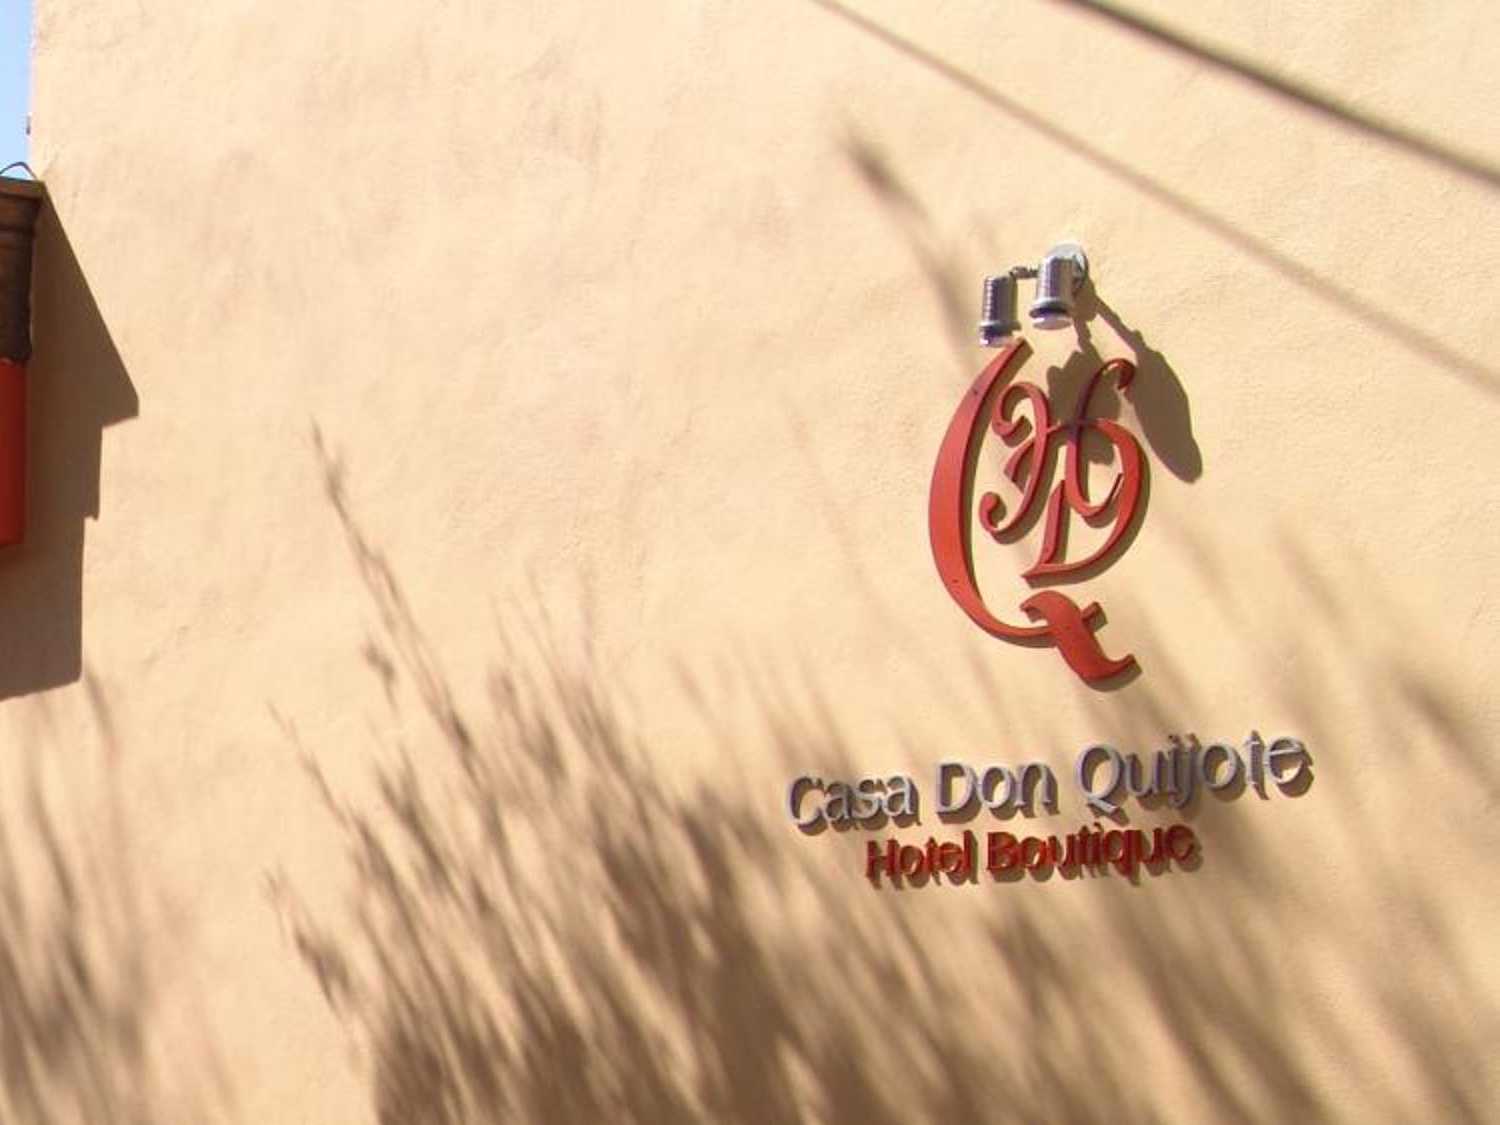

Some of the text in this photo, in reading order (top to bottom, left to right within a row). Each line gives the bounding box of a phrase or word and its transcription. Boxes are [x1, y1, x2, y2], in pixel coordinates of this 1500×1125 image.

[788, 731, 1309, 827] Casa Don Quijote
[866, 823, 1197, 880] Hotel Boutique
